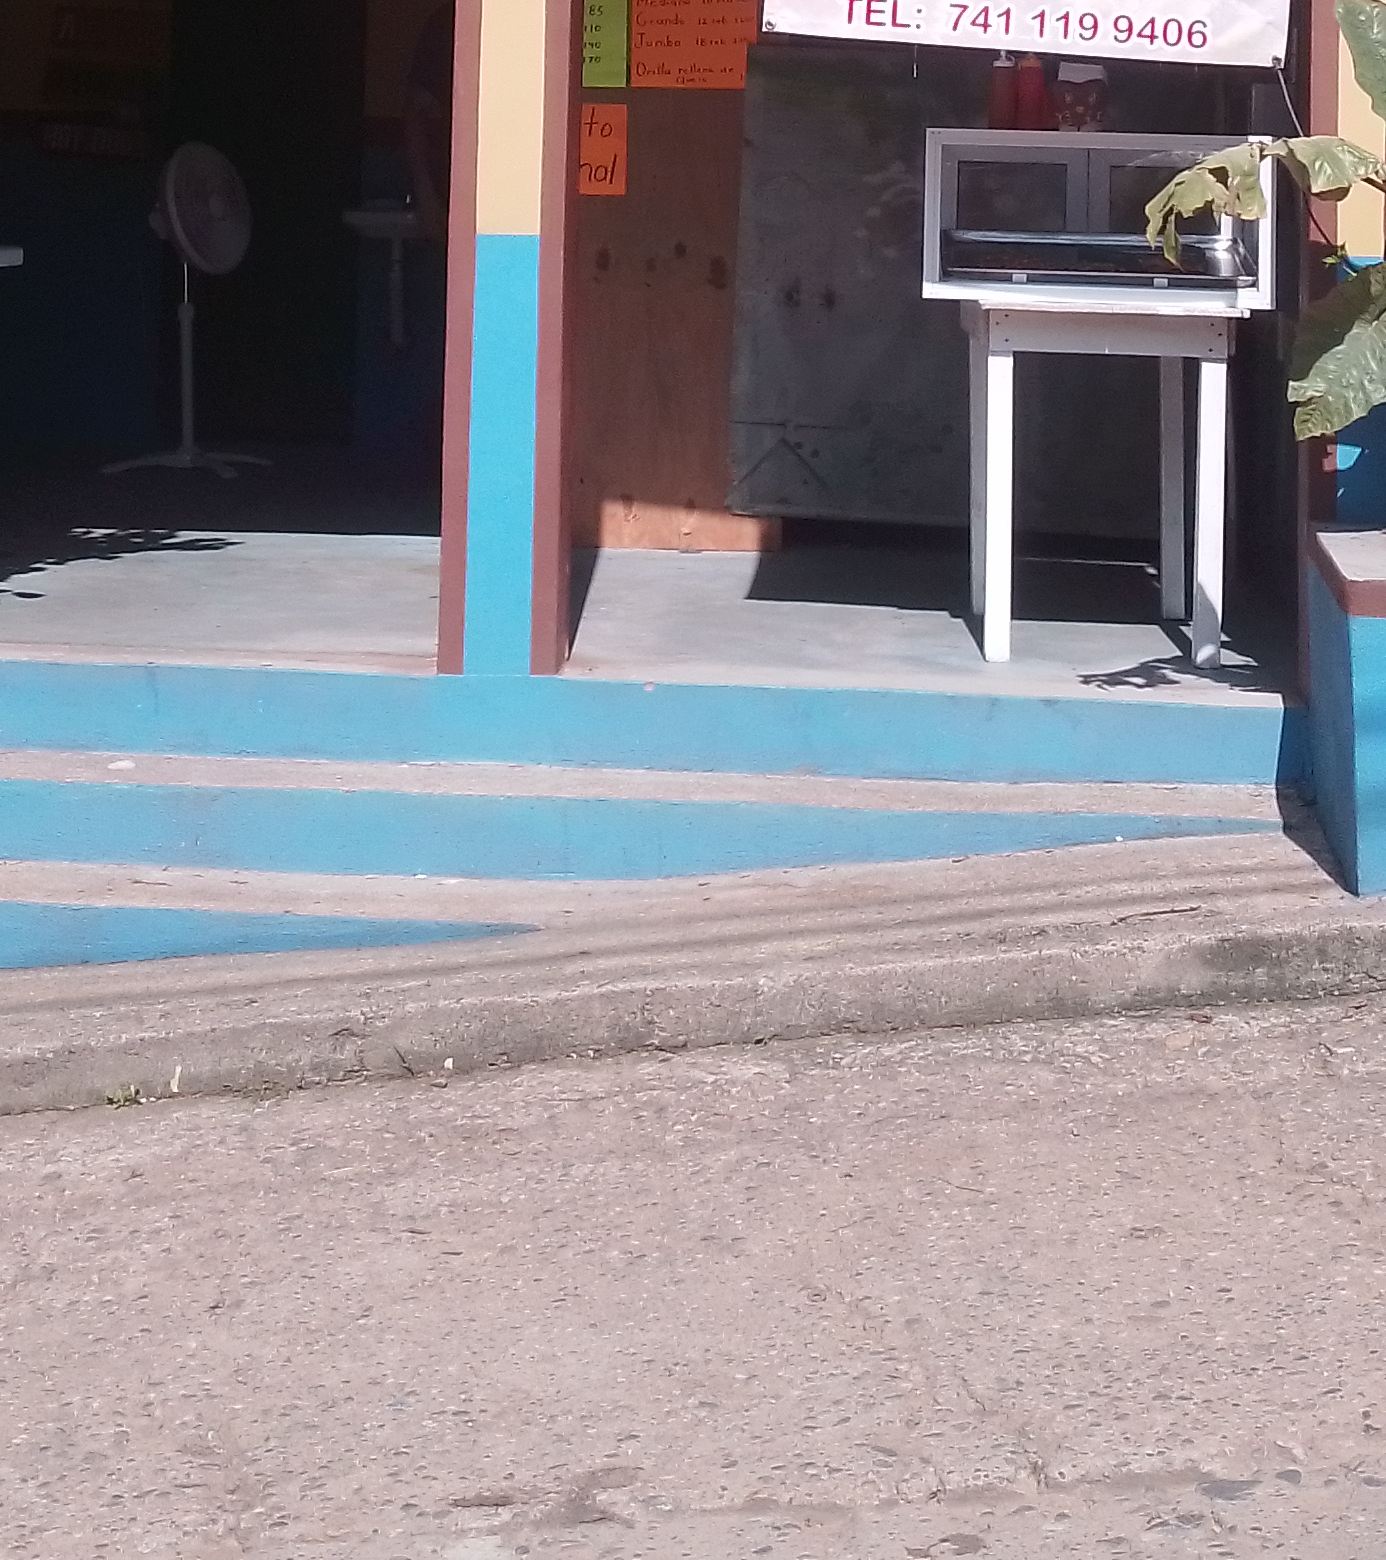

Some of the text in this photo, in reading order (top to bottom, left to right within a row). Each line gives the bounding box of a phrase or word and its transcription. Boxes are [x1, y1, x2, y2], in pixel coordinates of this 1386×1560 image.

[634, 32, 681, 49] Jumbo
[948, 2, 1014, 37] 741
[1031, 8, 1100, 41] 119
[1112, 13, 1209, 49] 9406
